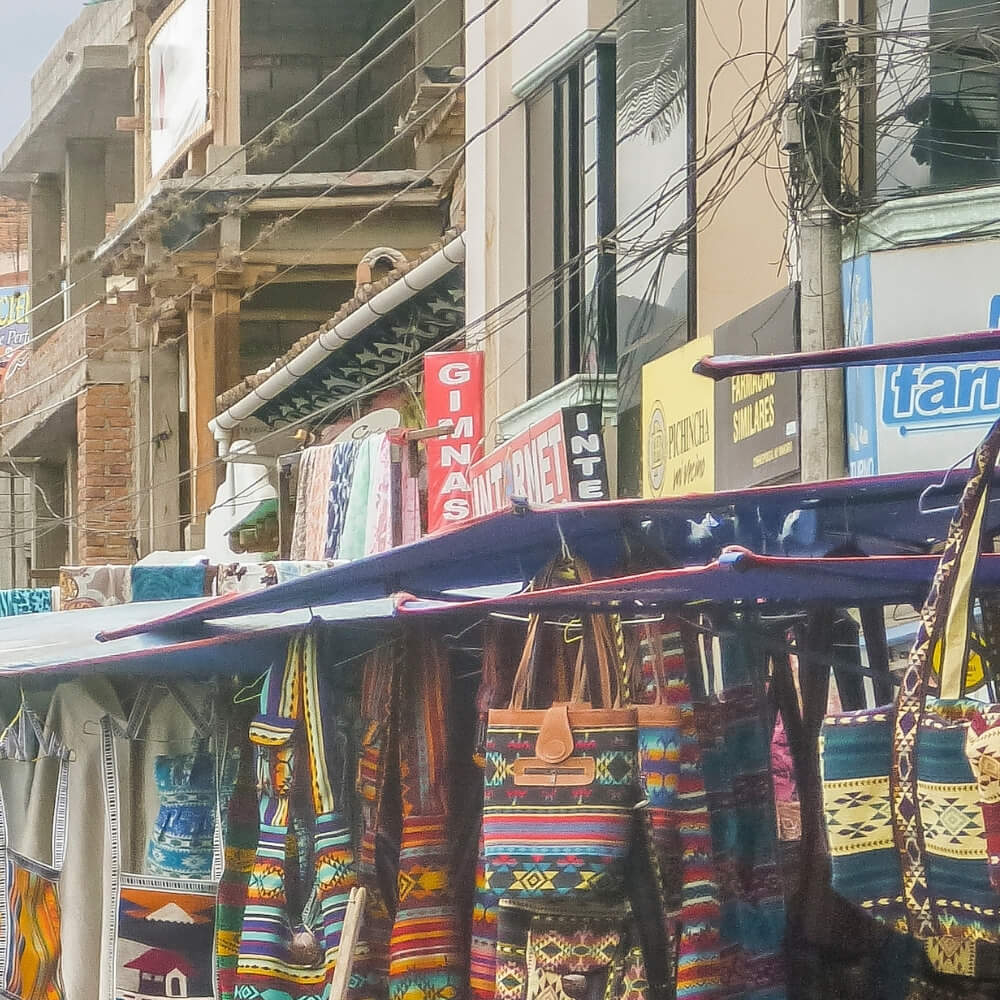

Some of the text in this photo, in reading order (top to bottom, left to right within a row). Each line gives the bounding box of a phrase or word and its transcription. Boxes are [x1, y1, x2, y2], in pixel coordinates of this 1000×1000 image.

[438, 362, 474, 520] GIMNAS
[668, 408, 710, 460] PICHINCHA
[733, 394, 775, 444] SIMILARES
[472, 424, 563, 519] INTRNET
